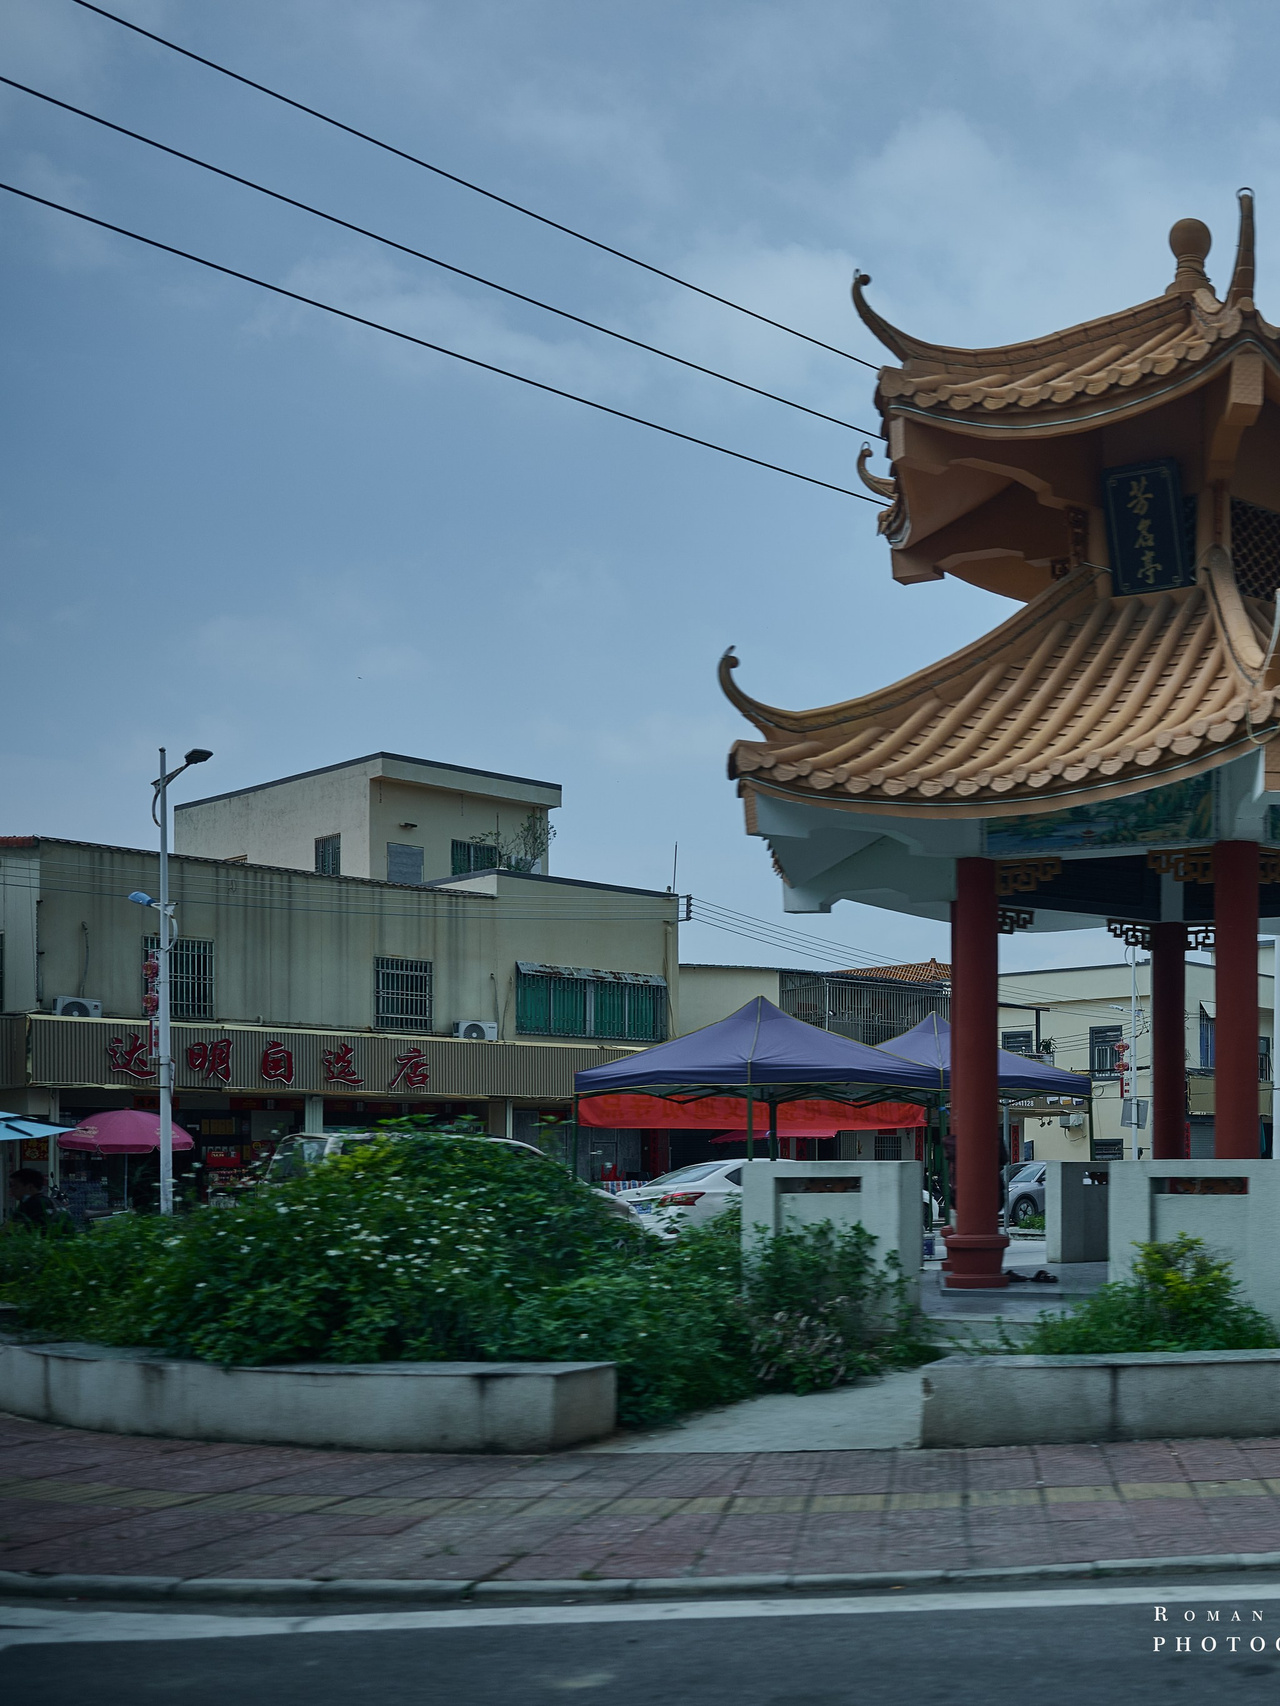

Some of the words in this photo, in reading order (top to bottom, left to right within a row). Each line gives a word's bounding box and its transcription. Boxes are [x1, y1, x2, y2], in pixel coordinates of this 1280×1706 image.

[1126, 476, 1162, 584] 芳名亭
[106, 1033, 430, 1088] 达明自选店
